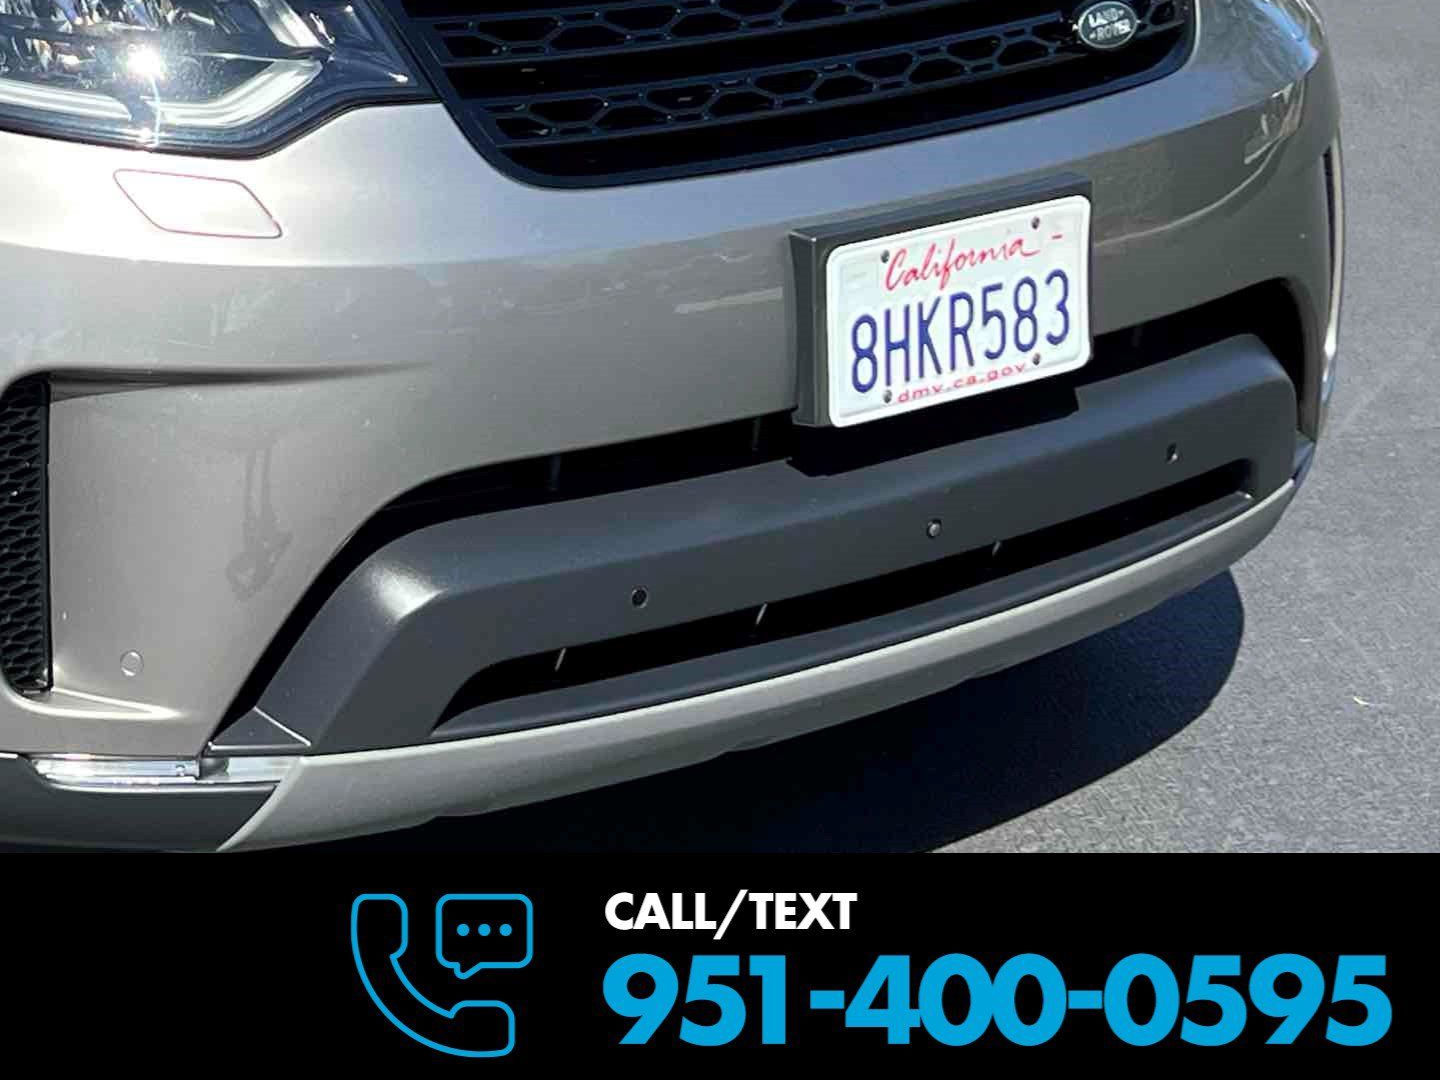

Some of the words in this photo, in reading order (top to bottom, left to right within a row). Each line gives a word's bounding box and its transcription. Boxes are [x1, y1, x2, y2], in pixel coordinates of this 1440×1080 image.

[884, 235, 1041, 291] California
[851, 269, 1070, 393] 8HKR583
[897, 361, 1026, 404] dmv.ca.gov
